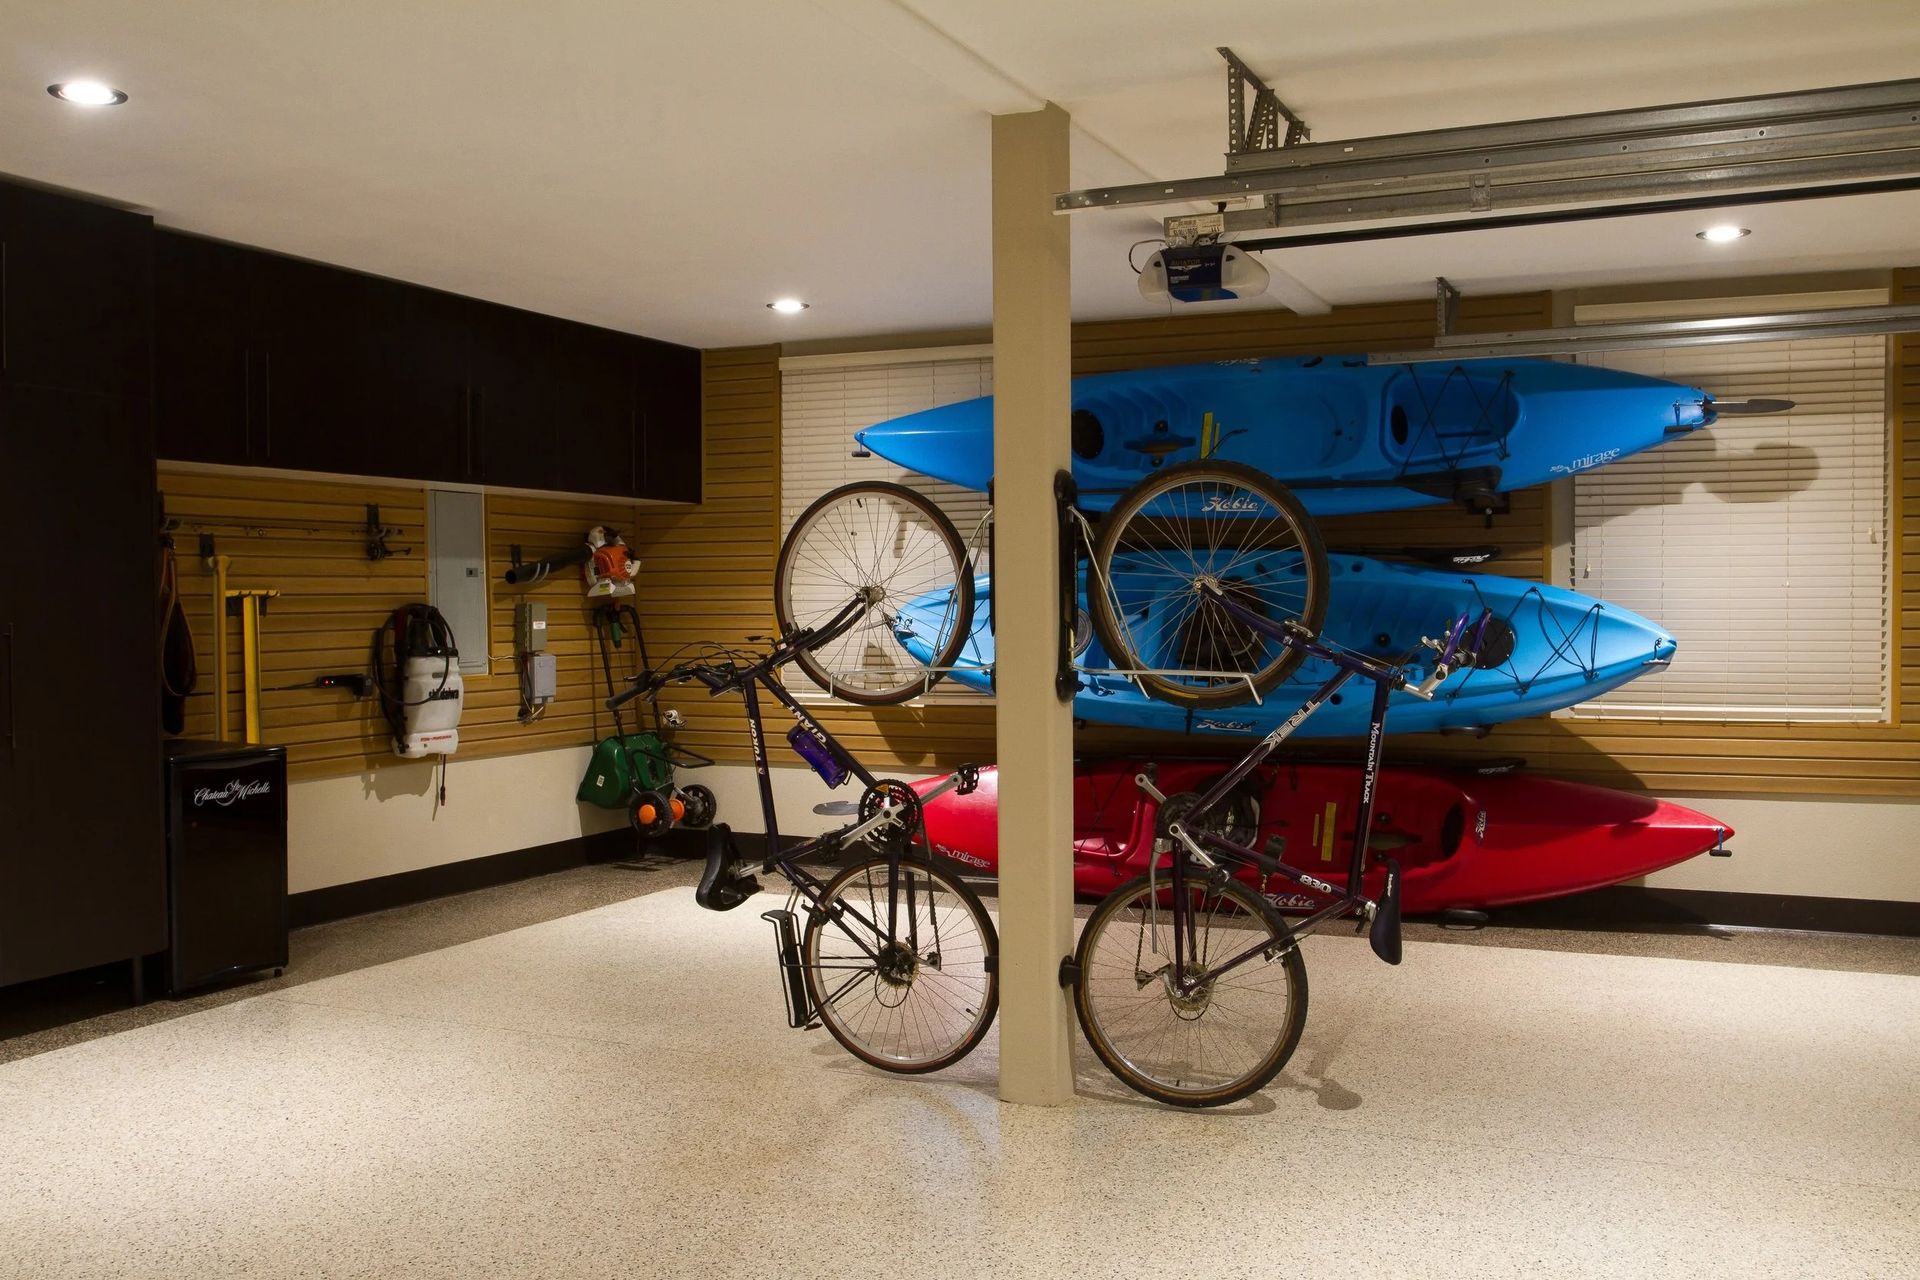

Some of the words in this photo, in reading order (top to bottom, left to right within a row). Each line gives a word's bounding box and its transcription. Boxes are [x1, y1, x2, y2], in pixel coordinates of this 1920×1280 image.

[1572, 447, 1621, 464] mirage
[1201, 496, 1258, 511] Hobie
[787, 705, 827, 743] GIANT
[1262, 700, 1321, 751] TREK
[749, 719, 761, 761] YUKON
[952, 850, 991, 868] mirage
[1299, 874, 1332, 894] 830
[1263, 893, 1316, 910] Hobie
